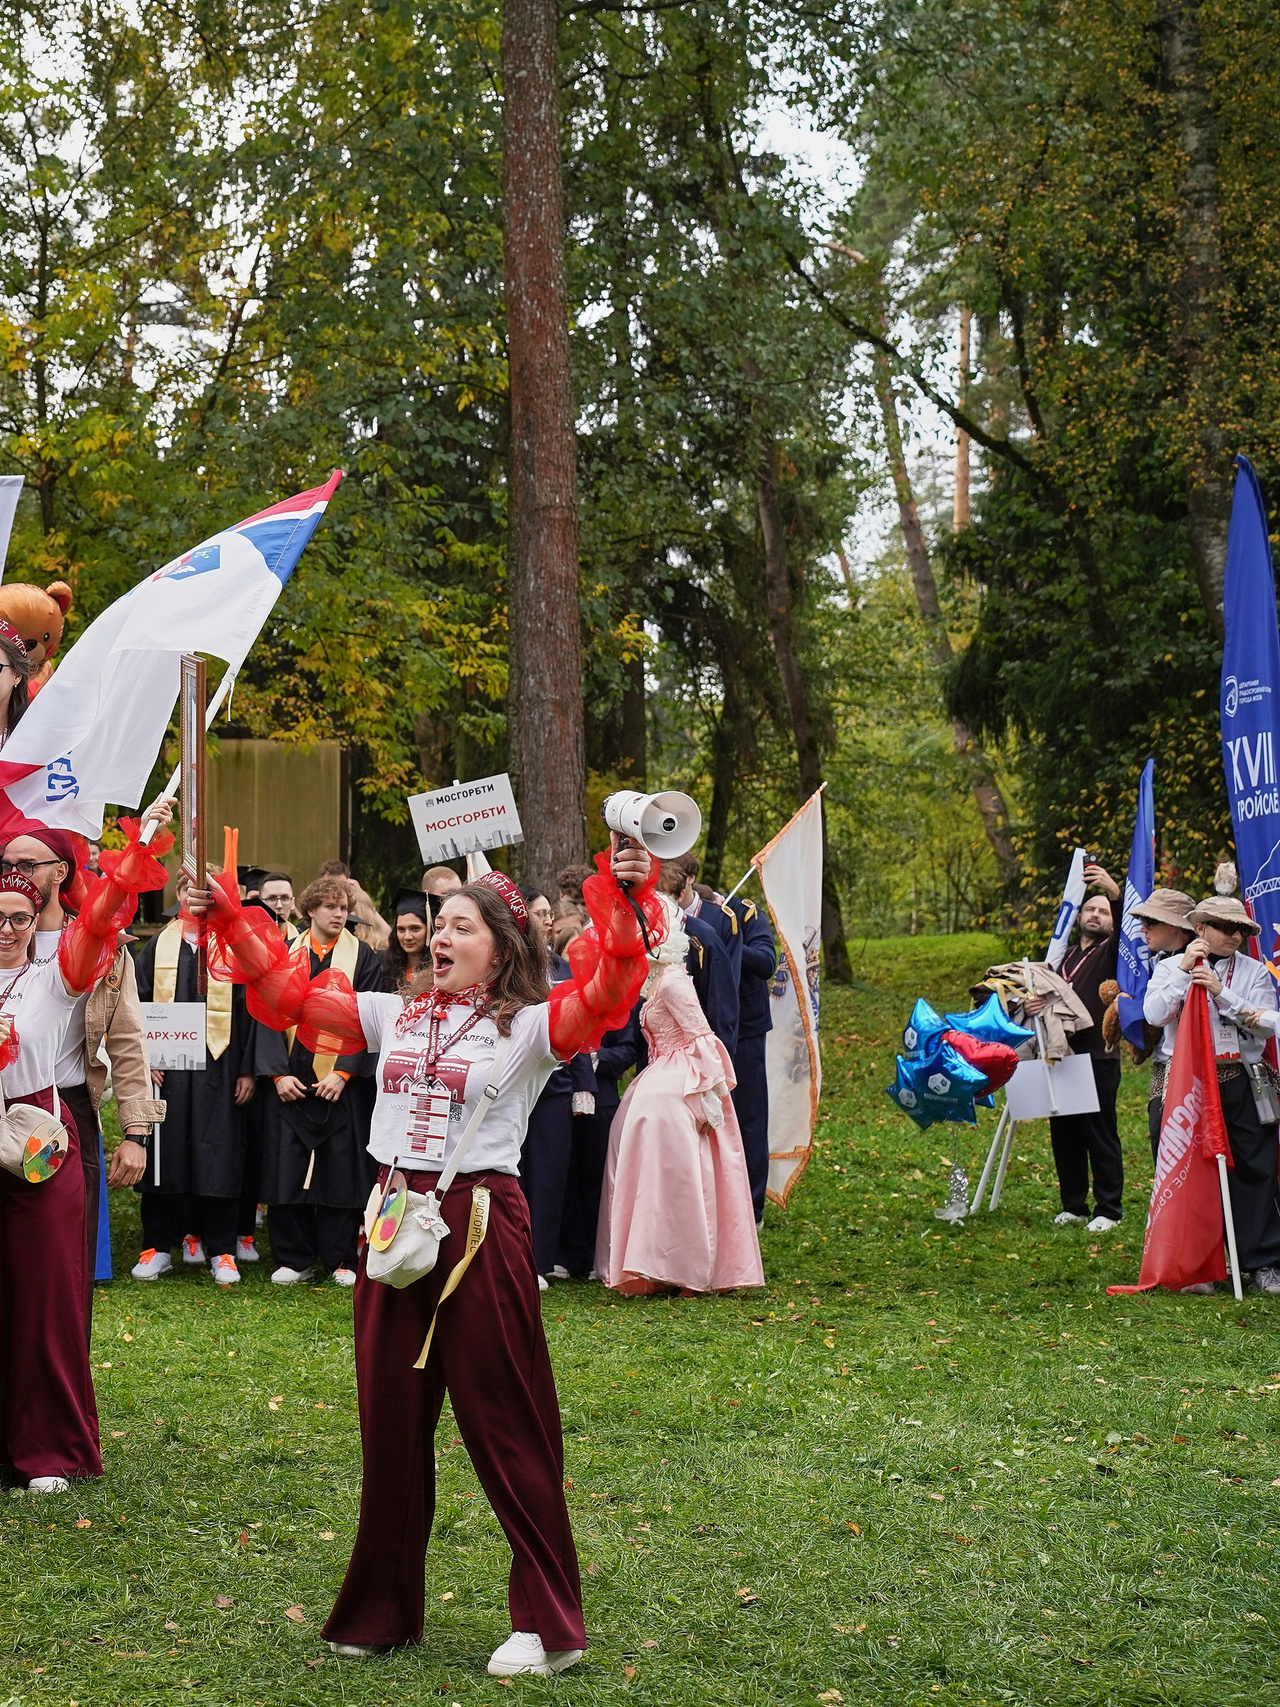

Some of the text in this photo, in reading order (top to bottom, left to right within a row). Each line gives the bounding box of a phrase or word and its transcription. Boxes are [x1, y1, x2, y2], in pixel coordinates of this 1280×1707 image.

[436, 784, 495, 805] МОСГОРБТИ
[425, 805, 506, 832] МОСГОРБТИ
[146, 1031, 198, 1040] АРХ-УКС
[458, 1034, 495, 1047] АЛЕРЕЯ
